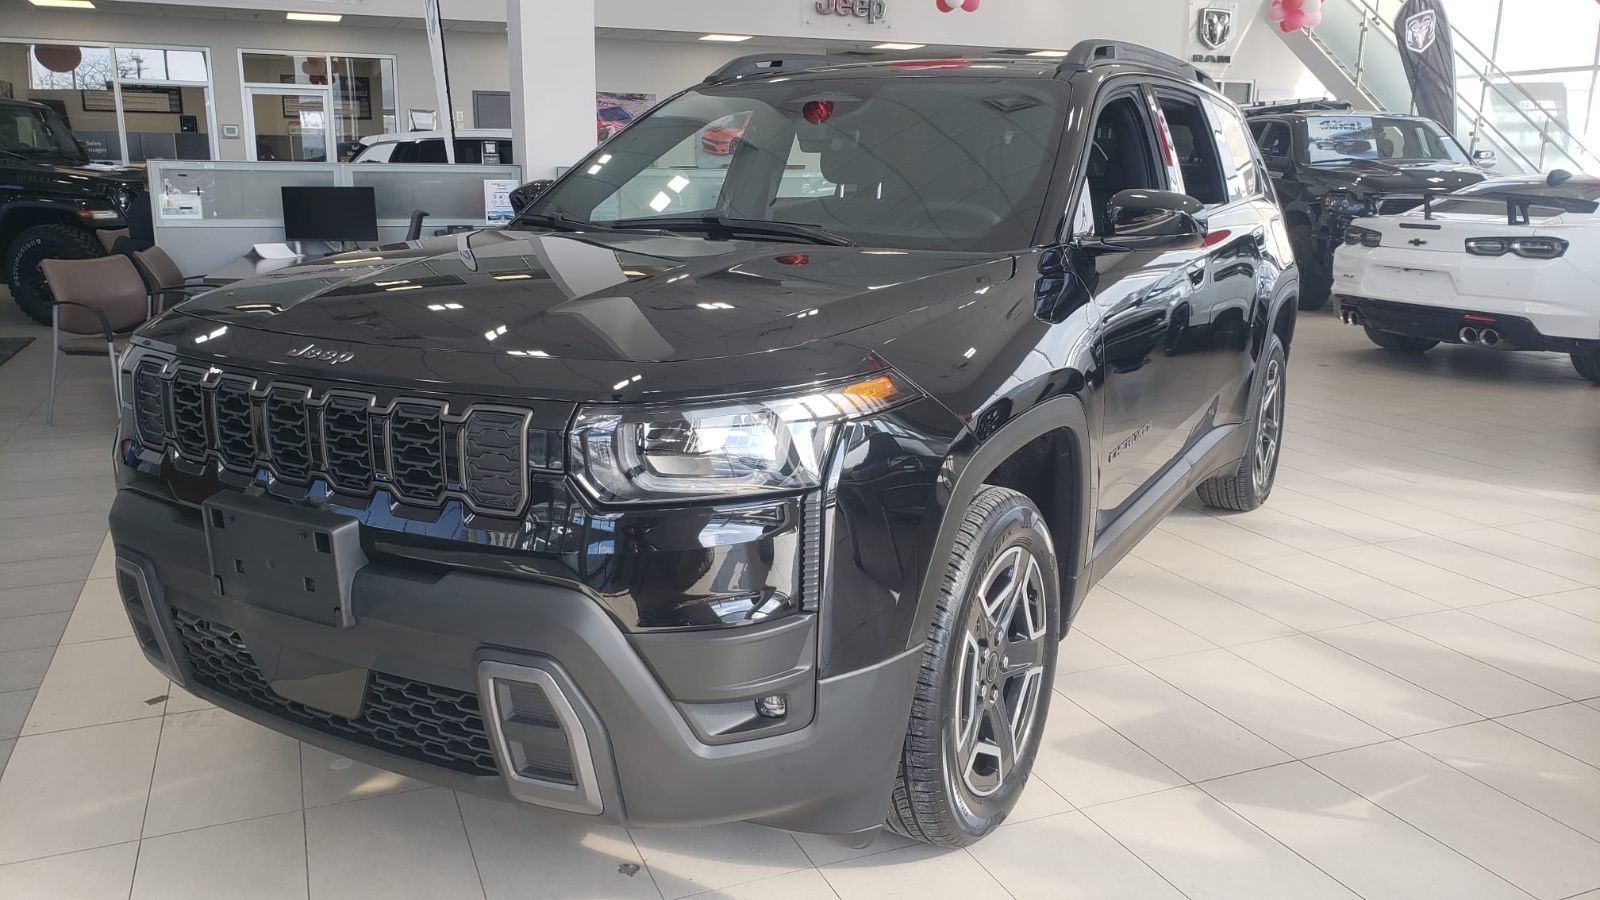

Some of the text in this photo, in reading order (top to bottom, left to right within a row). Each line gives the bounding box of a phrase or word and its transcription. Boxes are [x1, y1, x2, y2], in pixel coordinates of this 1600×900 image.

[816, 0, 886, 24] Jeep
[1192, 54, 1231, 64] RAM
[286, 343, 355, 365] Jeep
